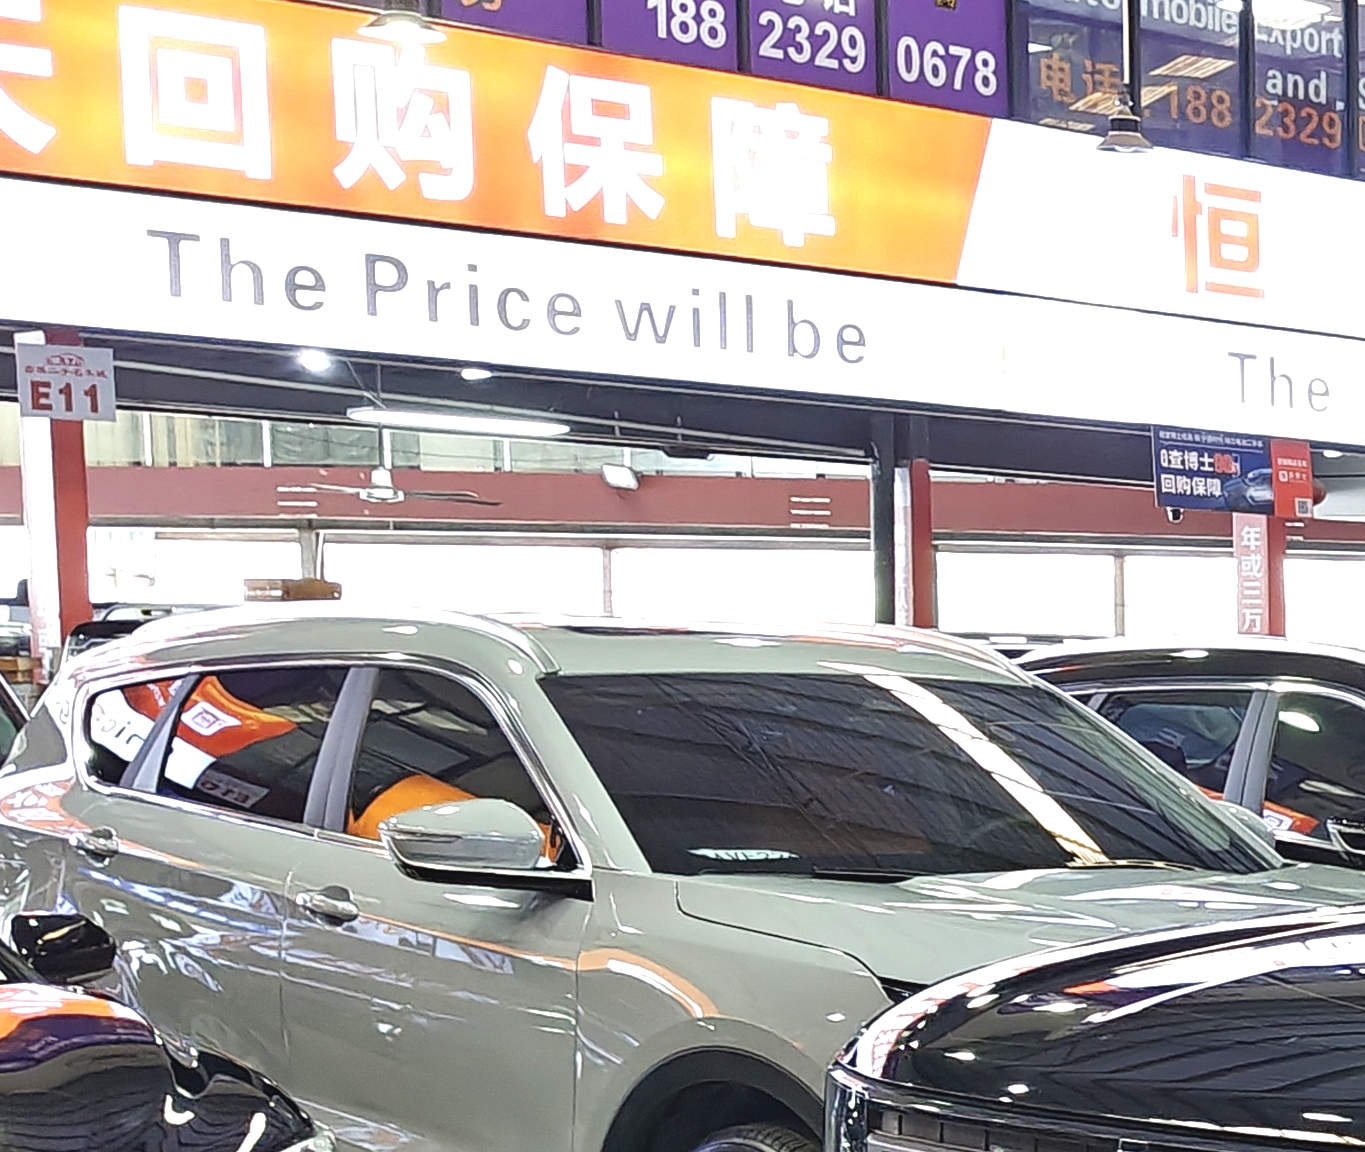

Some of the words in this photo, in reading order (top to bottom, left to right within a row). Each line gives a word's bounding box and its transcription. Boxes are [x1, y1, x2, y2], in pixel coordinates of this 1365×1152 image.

[646, 0, 726, 49] 188
[758, 11, 866, 73] 2329
[896, 36, 997, 97] 0678
[1265, 69, 1328, 104] and
[1255, 97, 1342, 149] 2329
[147, 229, 326, 313] The
[365, 253, 583, 337] Price
[614, 288, 755, 354] will
[785, 300, 867, 365] be
[29, 380, 99, 414] E11
[1227, 351, 1331, 415] The
[1160, 473, 1223, 499] 回购保障
